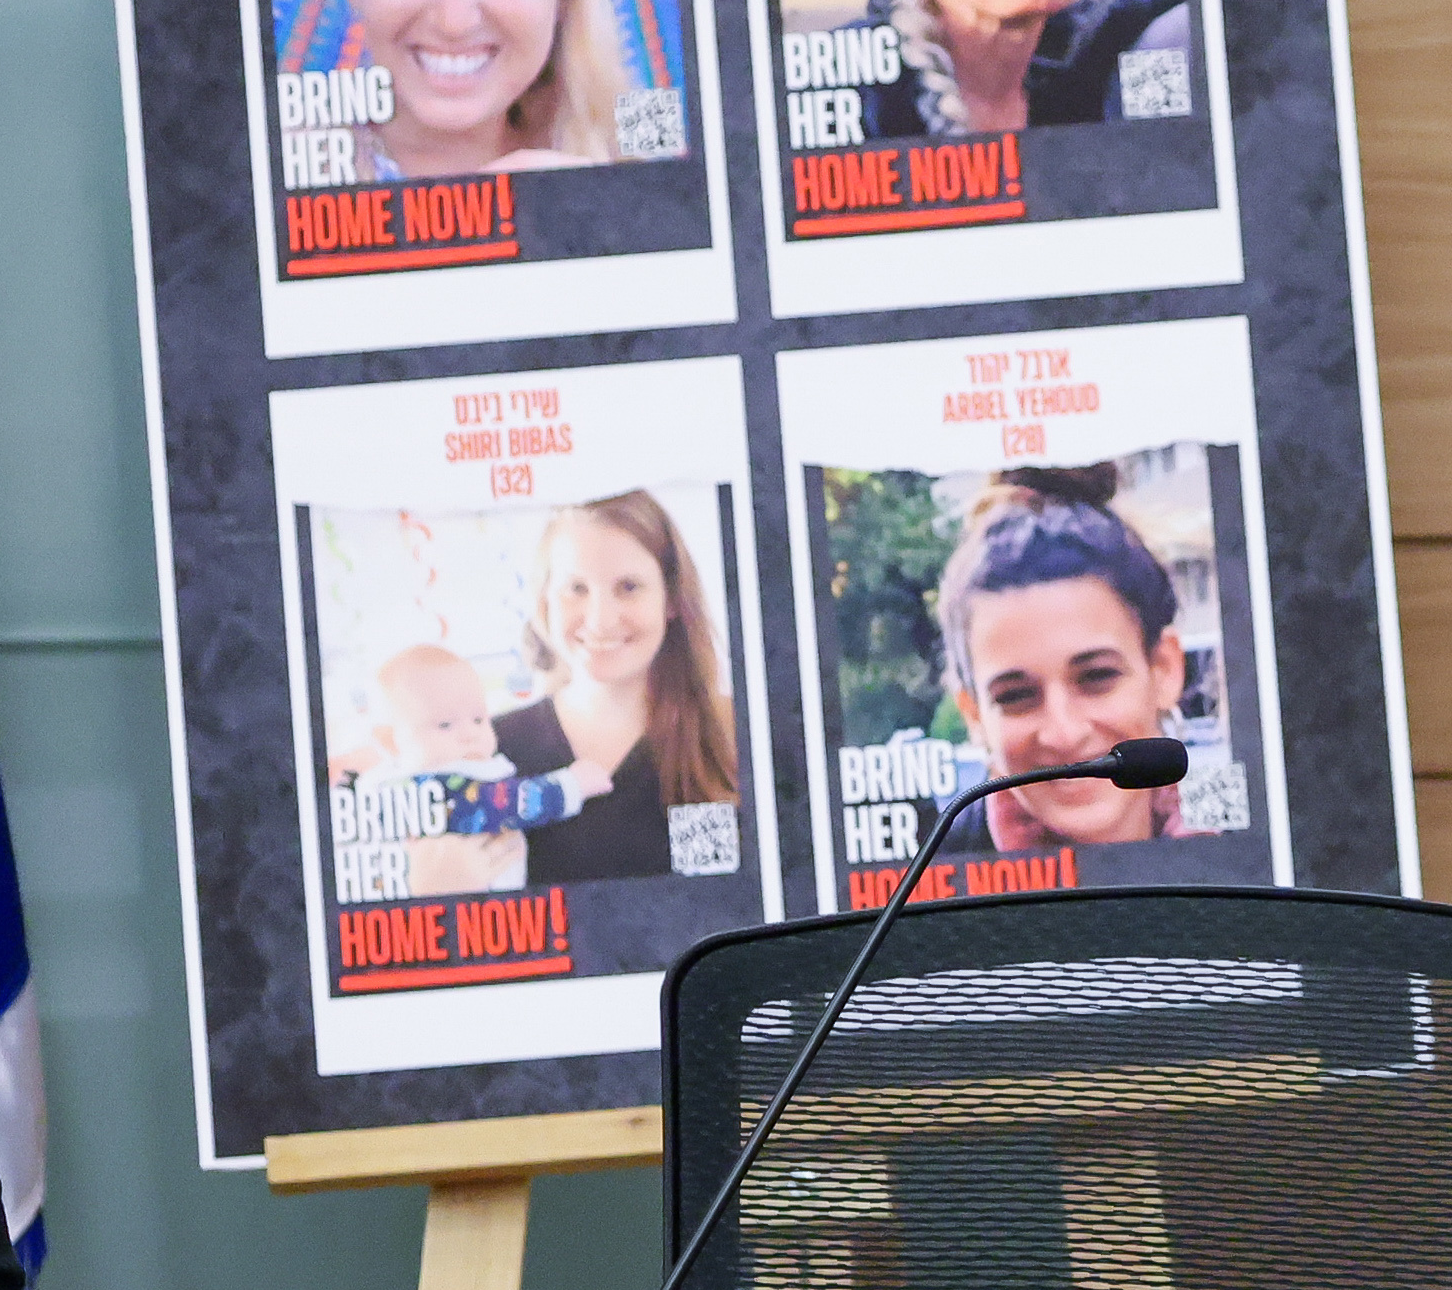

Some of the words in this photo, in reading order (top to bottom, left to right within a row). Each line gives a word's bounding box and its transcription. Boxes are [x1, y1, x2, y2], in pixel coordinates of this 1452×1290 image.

[783, 25, 900, 90] BRING
[277, 66, 394, 128] BRING
[787, 88, 864, 150] HER
[282, 128, 357, 189] HER
[793, 150, 902, 212] HOME
[909, 133, 1021, 202] NOW!
[287, 189, 395, 252] HOME
[402, 174, 514, 242] NOW!
[454, 392, 503, 424] ביבס
[510, 388, 558, 418] שירי
[943, 390, 1008, 422] ARBEL
[1015, 382, 1099, 417] YEHOUD
[445, 430, 501, 463] SHIRI
[509, 423, 573, 457] BIBAS
[491, 463, 533, 498] (32)
[839, 739, 956, 803] BRING
[330, 779, 447, 843] BRING
[843, 802, 919, 863] HER
[335, 841, 409, 904] HER
[339, 904, 448, 967] HOME
[456, 887, 568, 957] NOW!
